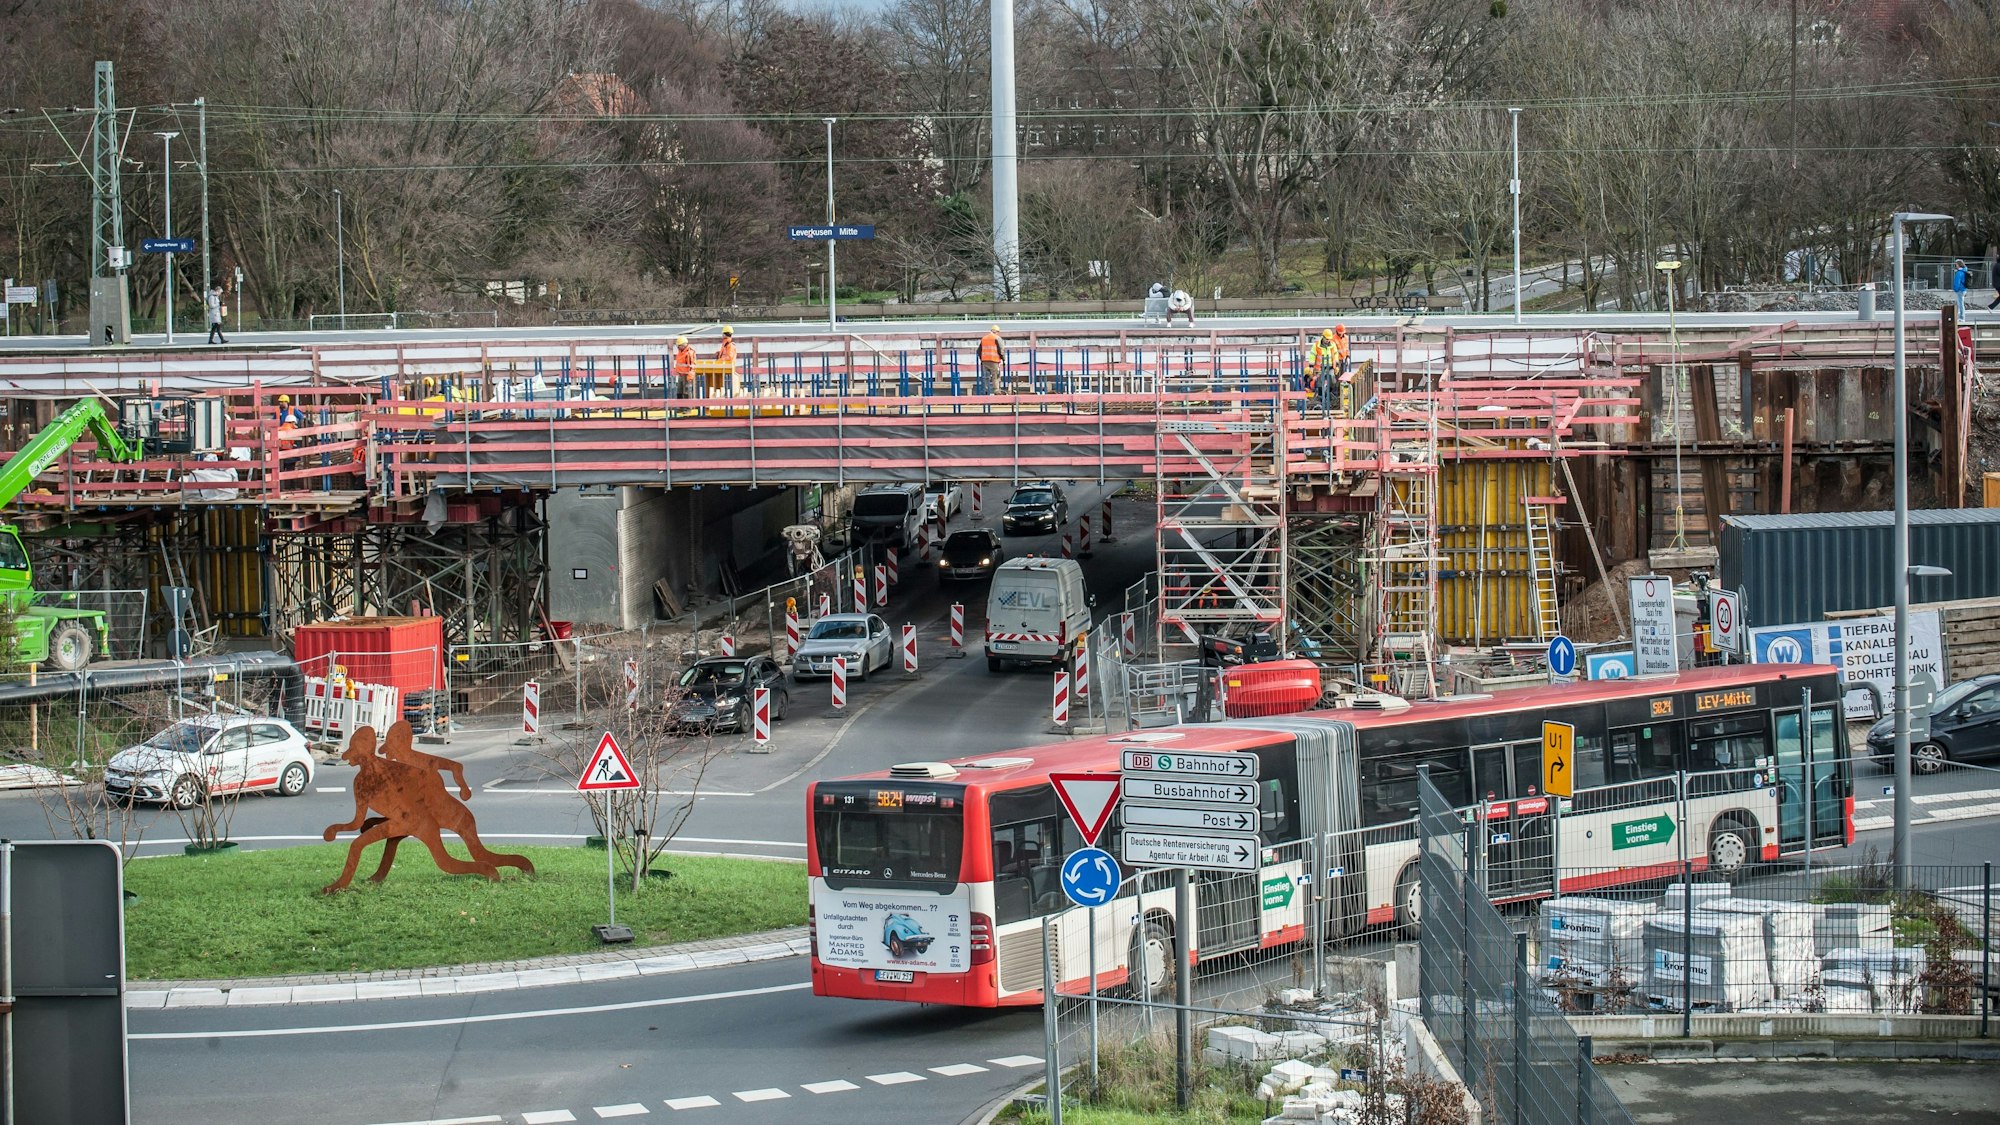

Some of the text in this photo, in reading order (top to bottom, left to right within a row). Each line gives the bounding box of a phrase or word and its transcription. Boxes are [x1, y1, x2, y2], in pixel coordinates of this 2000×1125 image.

[791, 227, 858, 237] Leverkusen Mitte
[40, 437, 67, 464] MERLO
[1016, 591, 1051, 608] EVL
[1719, 606, 1729, 624] 20
[1843, 622, 1896, 638] TIEFBAU
[1663, 636, 1671, 646] der
[1845, 635, 1914, 652] KANALBU
[1773, 644, 1795, 664] W
[1846, 648, 1930, 667] STOLLEAU
[1604, 668, 1621, 679] W
[1847, 662, 1938, 682] BOHRTEHNIK
[1549, 732, 1563, 750] U1
[1134, 756, 1150, 767] DB
[1177, 757, 1230, 772] Bahnhof
[1154, 783, 1230, 799] Busbahnhof
[843, 790, 937, 807] 131 SB24 wupsi
[1517, 799, 1547, 810] einsteigen
[1202, 813, 1231, 827] Post
[1625, 821, 1658, 835] Einstieg
[1130, 836, 1230, 853] Deutsche Rentenversicherung
[1625, 833, 1650, 844] vorne
[1149, 850, 1176, 861] Agentur
[1177, 851, 1187, 861] für
[1188, 851, 1209, 863] Arbeit
[1216, 853, 1230, 864] AGL
[832, 868, 948, 879] CITARO Mercedes-Benz
[1263, 881, 1290, 895] Einstieg
[842, 900, 938, 913] Vom Weg abgekommen... ??
[1264, 894, 1284, 906] vorne
[823, 912, 868, 923] Unfallgutachten
[837, 922, 854, 931] durch
[1560, 916, 1601, 934] kronimus
[828, 941, 865, 949] MANFRED
[829, 934, 863, 942] Ingenieur-Büro
[830, 947, 864, 957] ADAMS
[886, 958, 937, 968] www.sv-adams.de
[1664, 954, 1708, 976] kronmus
